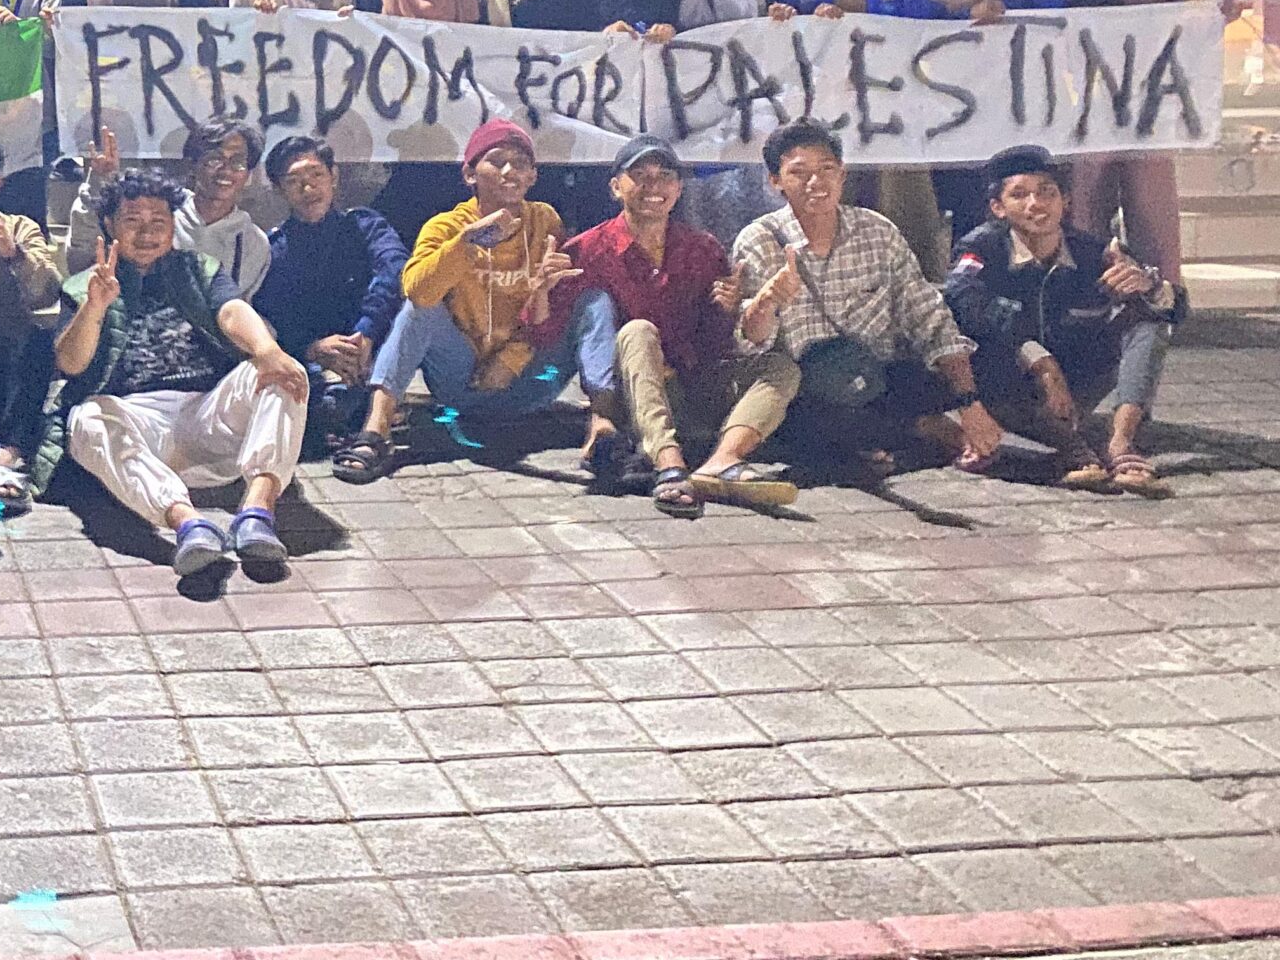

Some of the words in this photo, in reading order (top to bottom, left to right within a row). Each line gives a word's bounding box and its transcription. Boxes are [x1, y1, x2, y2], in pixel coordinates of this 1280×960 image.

[82, 18, 488, 144] FREEDOM
[515, 45, 631, 134] FOR
[663, 16, 1207, 143] PALESTINA
